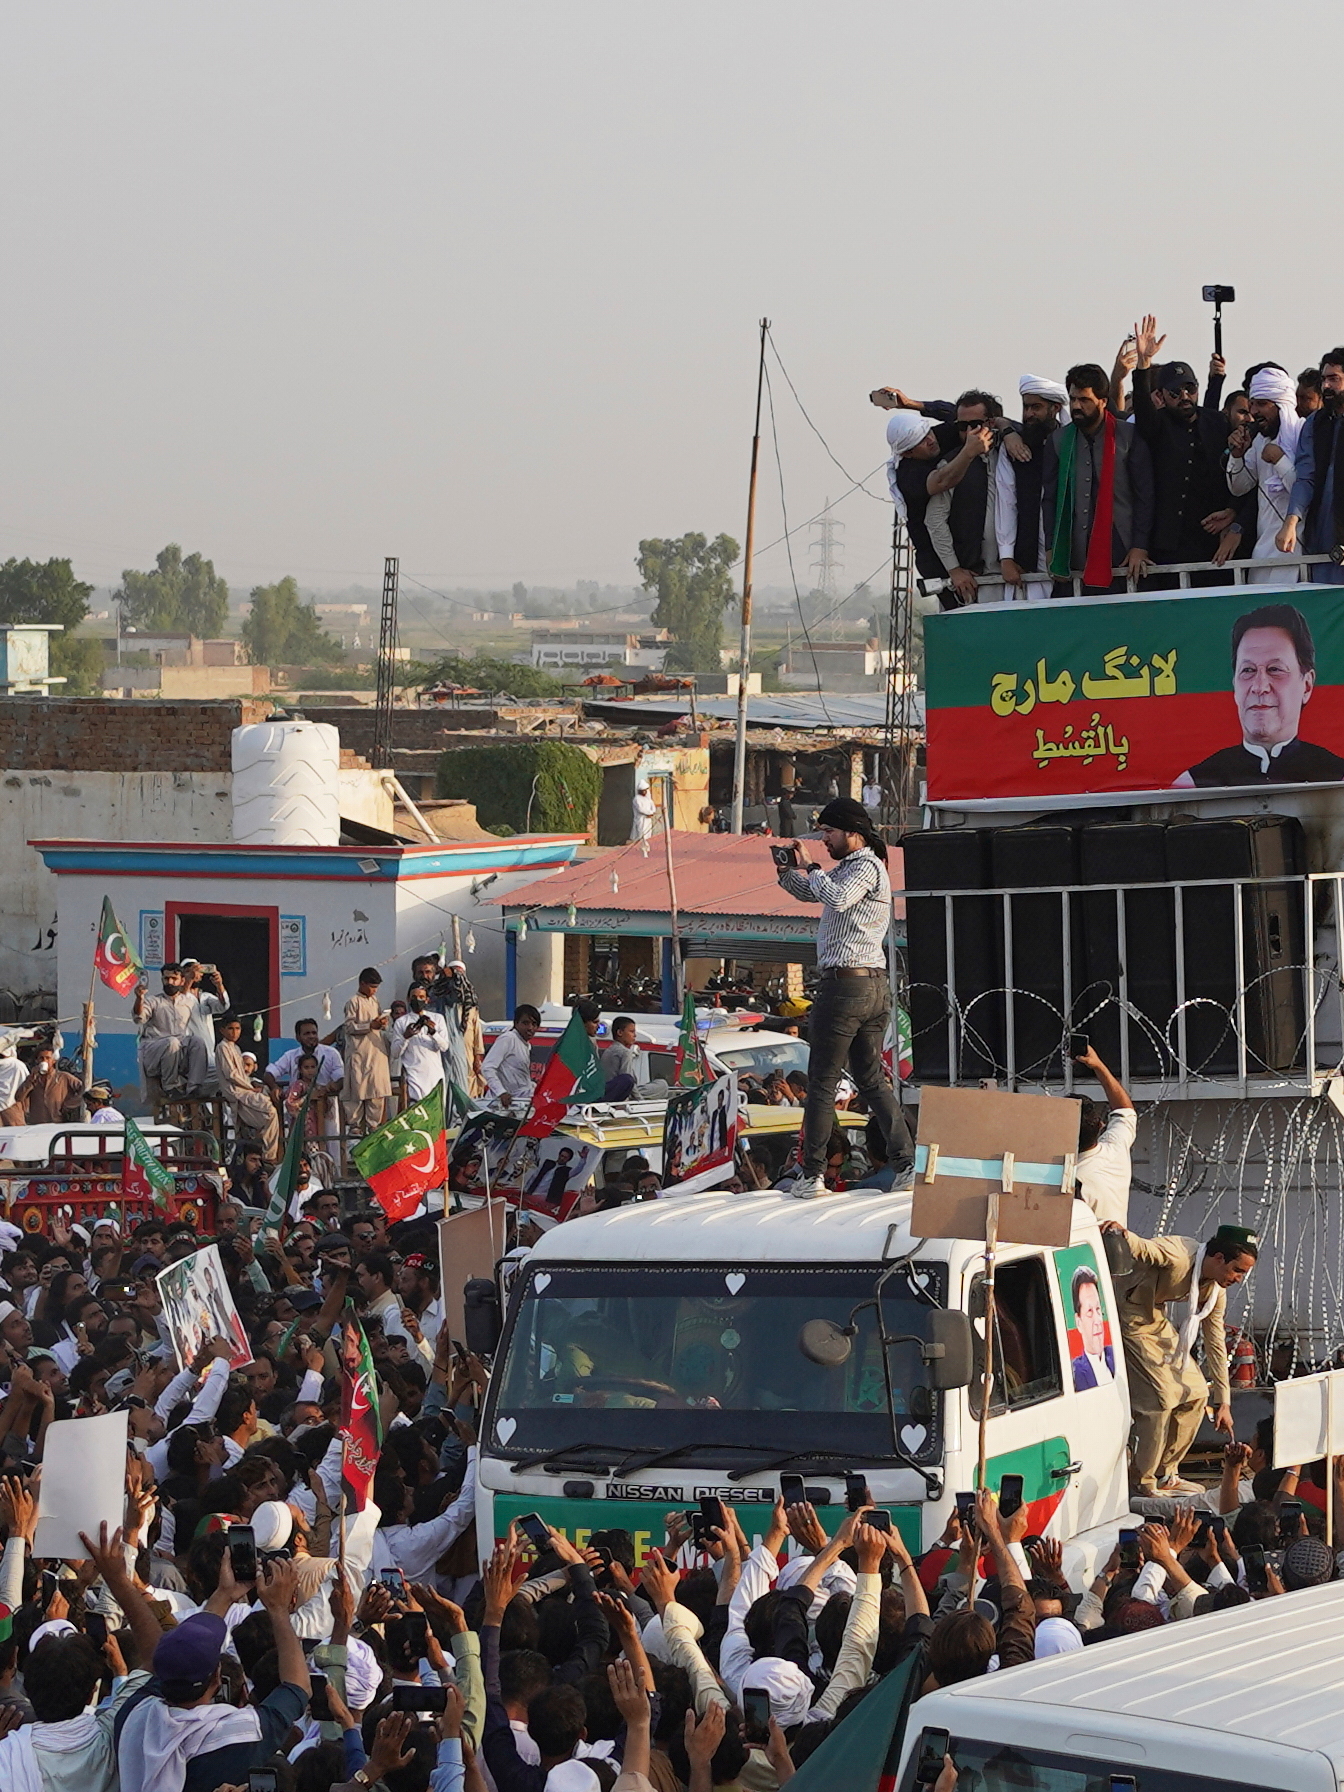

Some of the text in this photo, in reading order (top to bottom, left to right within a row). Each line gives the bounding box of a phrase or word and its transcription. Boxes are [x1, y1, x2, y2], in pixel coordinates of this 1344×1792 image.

[990, 646, 1177, 717] لانگ مارچ
[608, 1485, 770, 1502] NISSAN DIESEL
